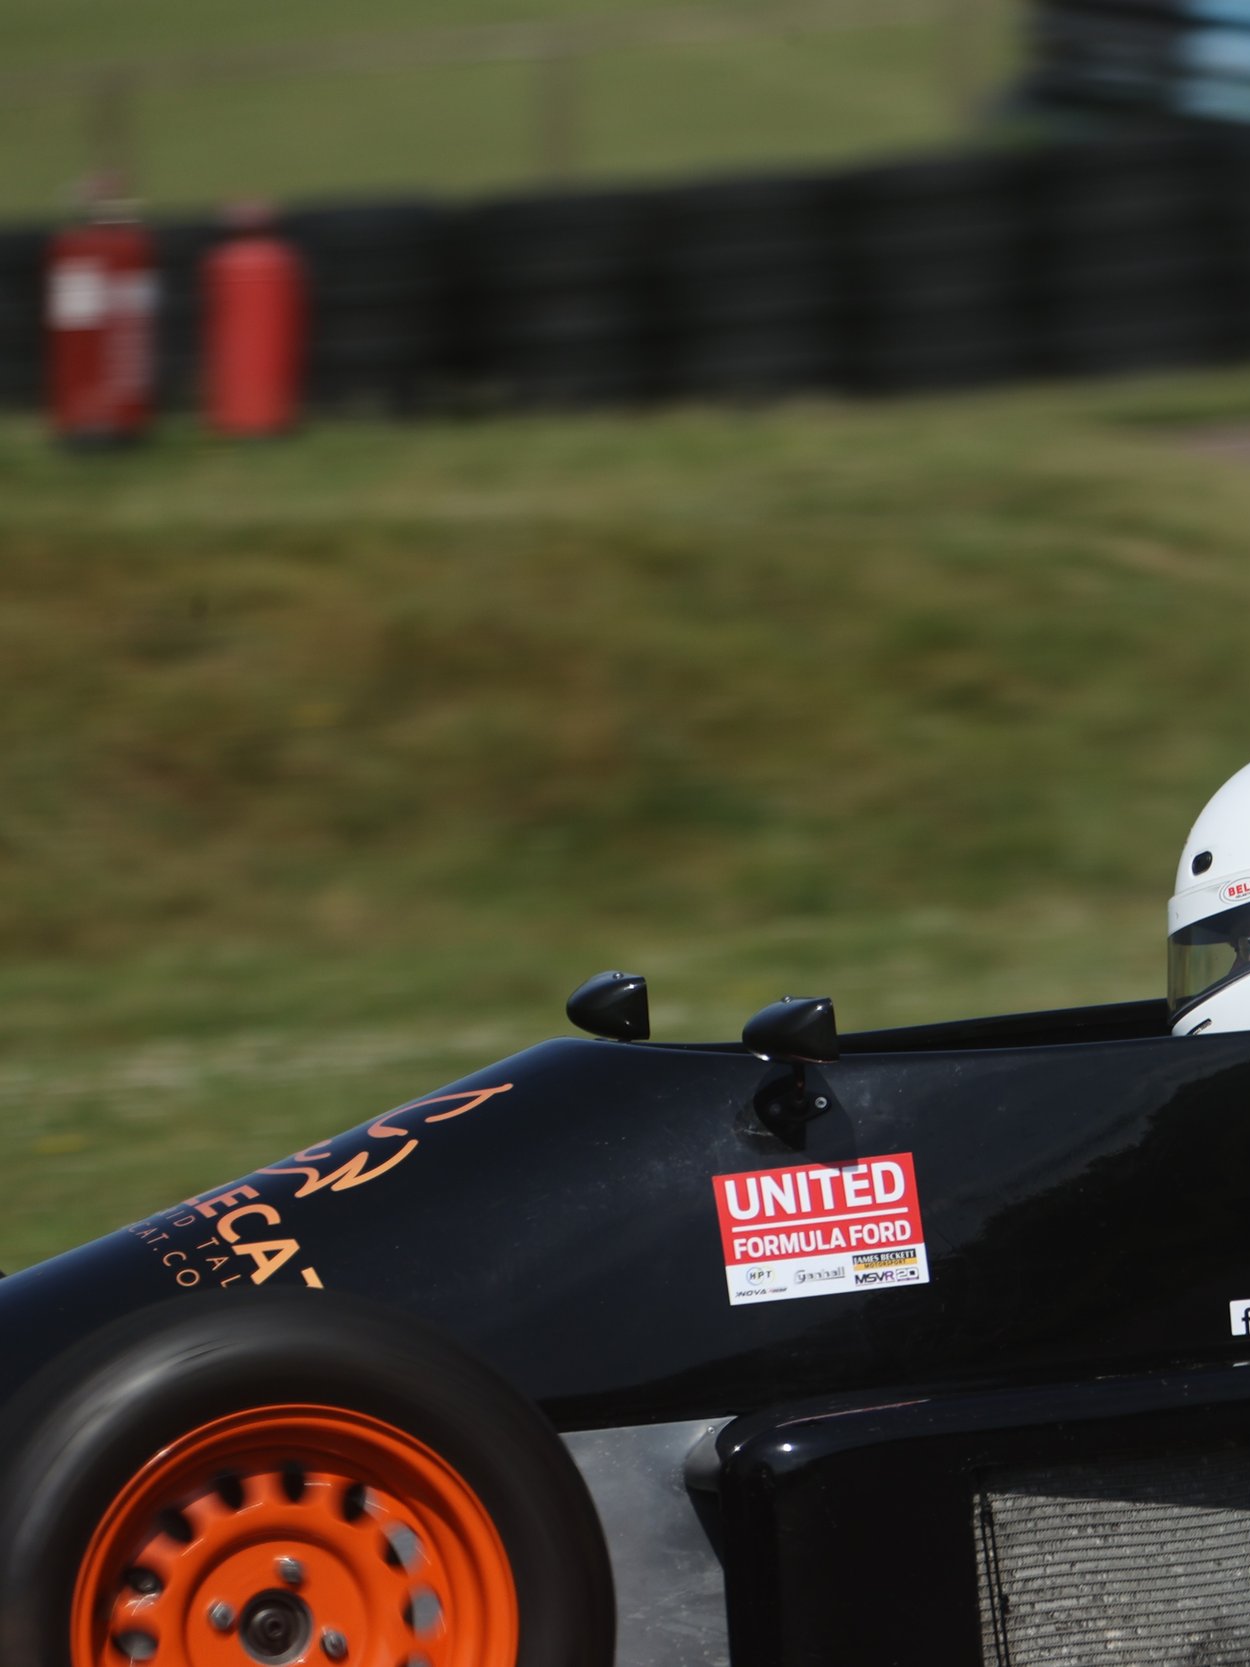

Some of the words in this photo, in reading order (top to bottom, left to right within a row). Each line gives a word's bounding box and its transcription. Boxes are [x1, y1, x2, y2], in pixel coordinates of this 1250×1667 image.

[724, 1161, 906, 1220] UNITED
[733, 1227, 849, 1261] FORMULA
[850, 1220, 912, 1248] FORD
[854, 1253, 880, 1265] JAMES
[881, 1250, 915, 1261] BECKETT
[854, 1271, 894, 1285] MSVR
